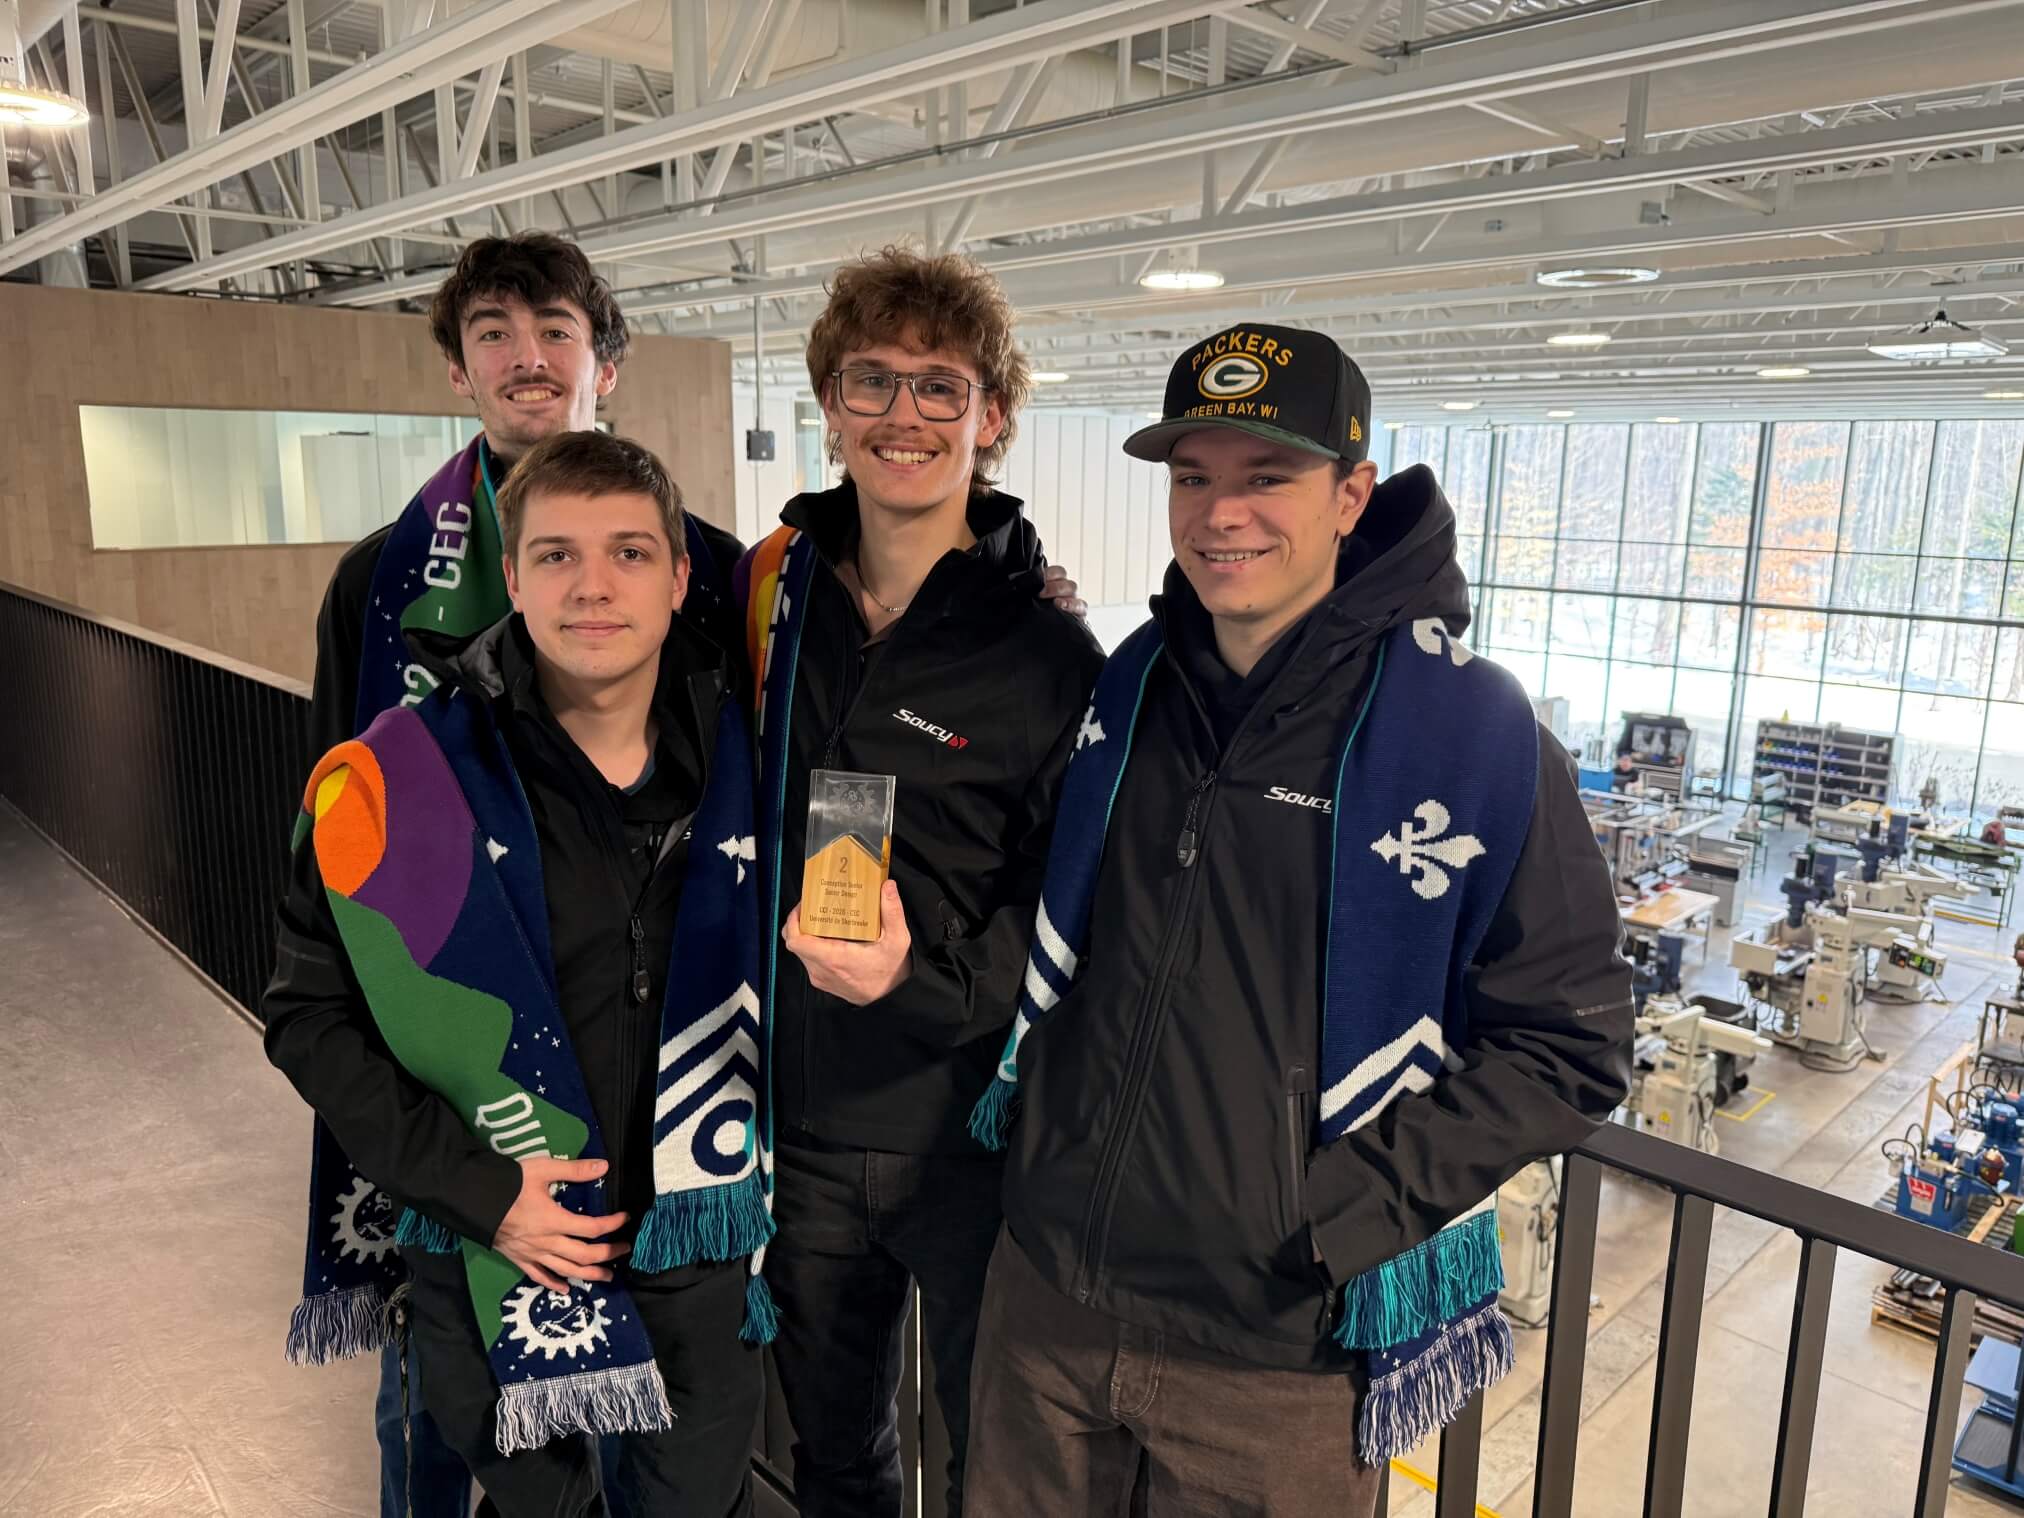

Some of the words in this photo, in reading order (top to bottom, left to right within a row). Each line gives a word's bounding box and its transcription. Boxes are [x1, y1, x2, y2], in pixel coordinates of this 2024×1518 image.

[1192, 331, 1293, 371] PACKERS
[1227, 402, 1256, 417] BAY,
[1260, 403, 1278, 419] WI
[423, 501, 472, 590] CEC
[839, 857, 849, 874] 2
